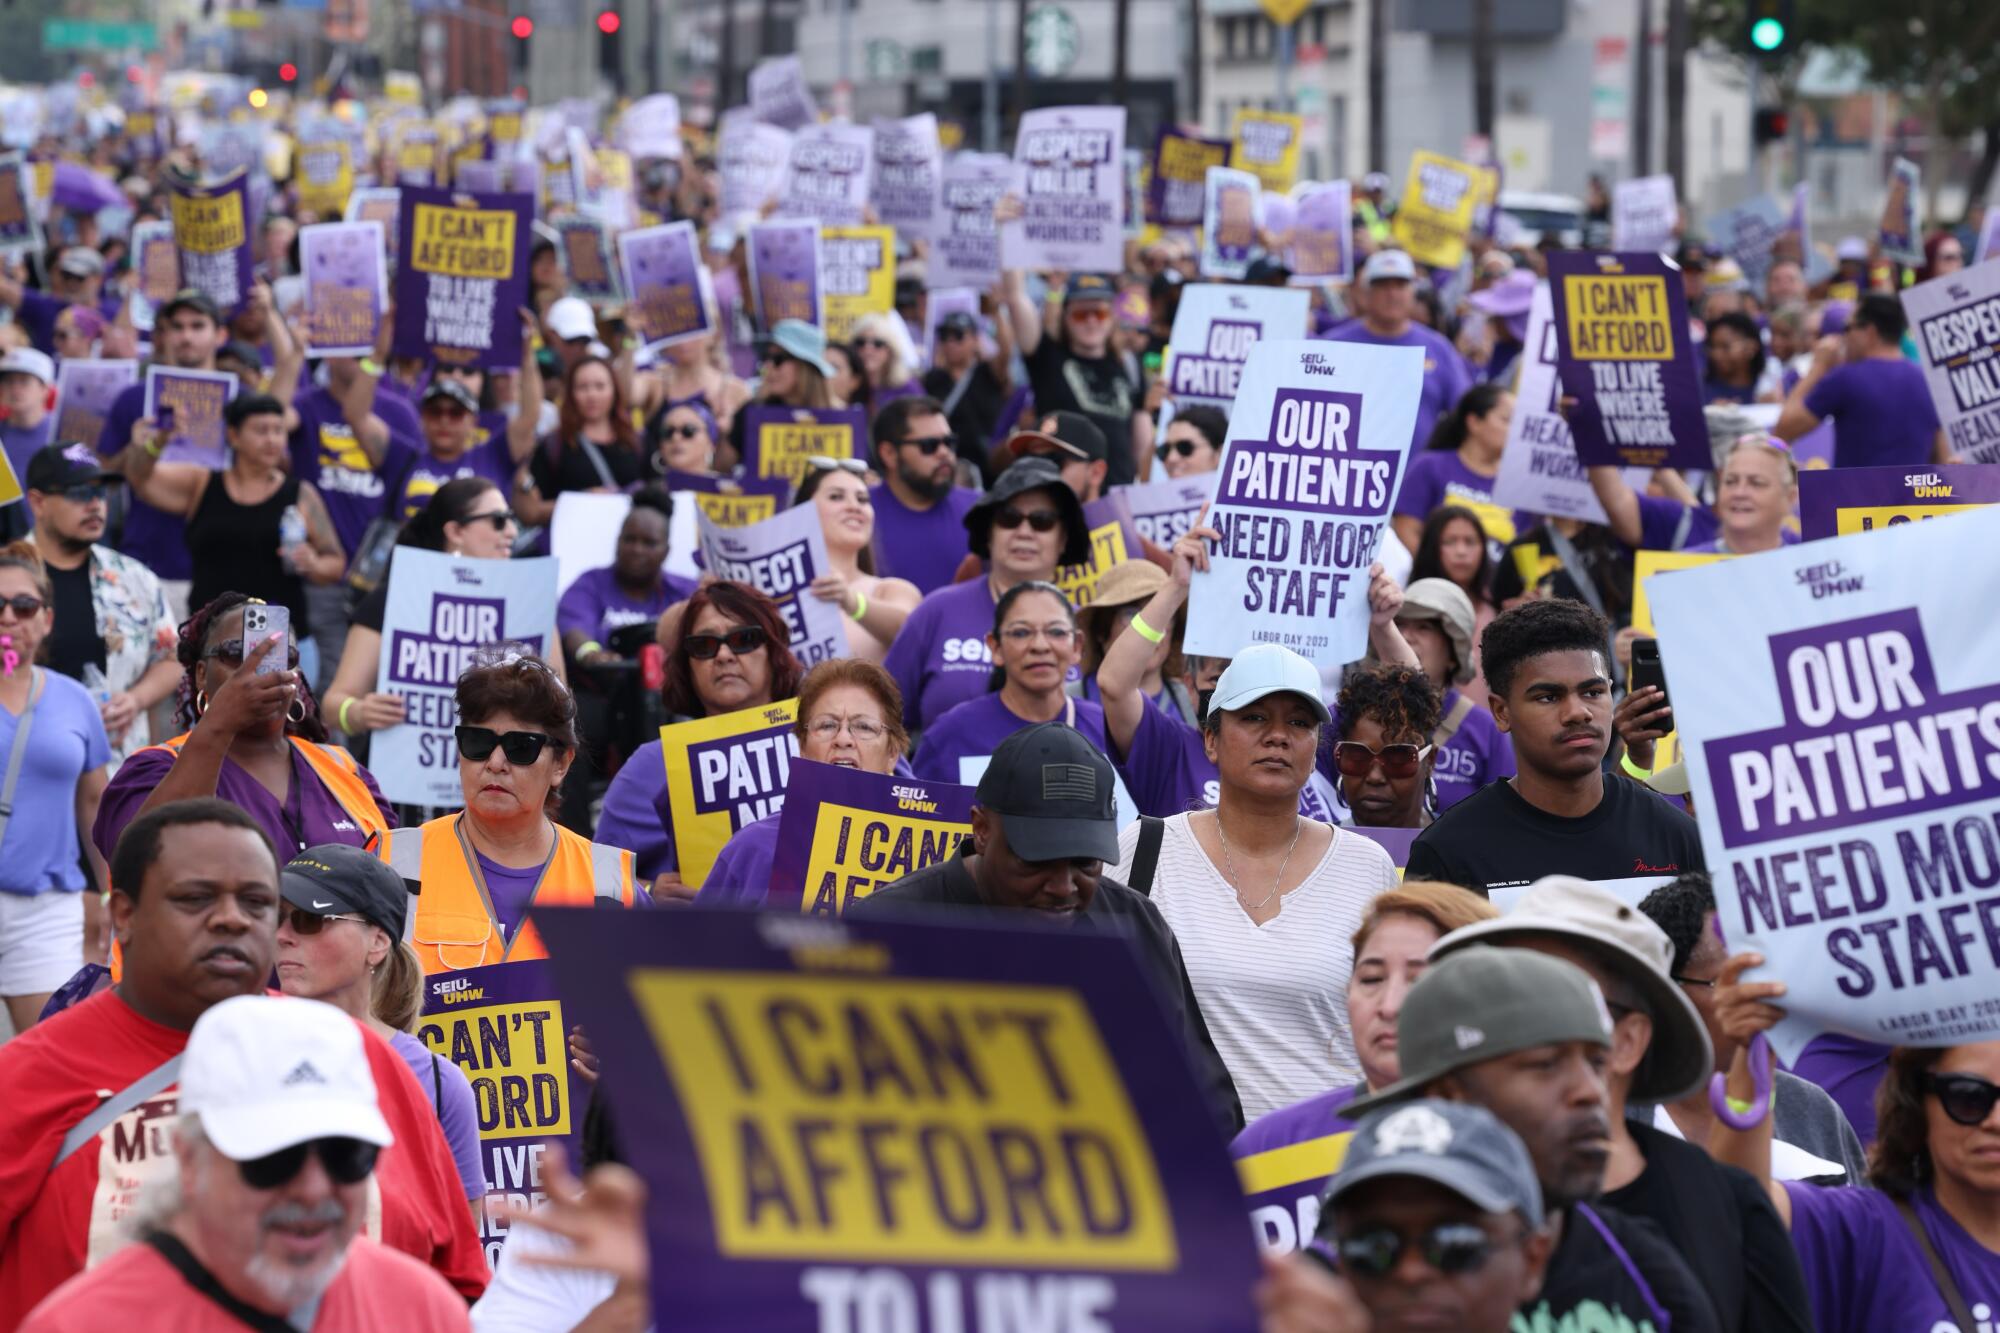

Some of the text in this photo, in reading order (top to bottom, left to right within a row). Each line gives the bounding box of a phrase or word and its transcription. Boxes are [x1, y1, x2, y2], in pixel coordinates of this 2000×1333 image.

[1026, 133, 1107, 160] RESPECT
[441, 214, 508, 241] CAN'T
[420, 242, 507, 273] AFFORD
[1577, 283, 1660, 315] I CAN'T
[1578, 321, 1666, 354] AFFORD
[1300, 353, 1328, 364] SEIU-
[1304, 364, 1336, 376] UHW
[1591, 362, 1665, 391] TO LIVE
[1595, 390, 1669, 417] WHERE
[1275, 398, 1351, 452] OUR
[1601, 416, 1676, 446] I WORK
[1227, 449, 1391, 510] PATIENTS
[1904, 473, 1941, 487] SEIU-
[1914, 485, 1953, 498] UHW
[1210, 511, 1384, 570] NEED MORE
[1795, 560, 1847, 585] SEIU-
[1811, 576, 1864, 600] UHW
[1243, 565, 1351, 619] STAFF
[435, 600, 499, 643] OUR
[1252, 630, 1328, 648] LABOR DAY 2023
[1787, 629, 1926, 728] OUR
[388, 687, 454, 729] EED
[1729, 700, 2000, 832] PATIENTS
[890, 784, 929, 799] SEIU-
[897, 799, 939, 814] UHW
[835, 816, 852, 866] I
[1732, 808, 2000, 935] NEED MO
[432, 977, 472, 995] SEIU-
[443, 987, 485, 1005] UHW
[417, 1010, 551, 1072] CAN'T
[701, 992, 1073, 1110] I CAN'T
[733, 1110, 1141, 1240] AFFORD
[800, 1266, 1118, 1333] TO LIVE
